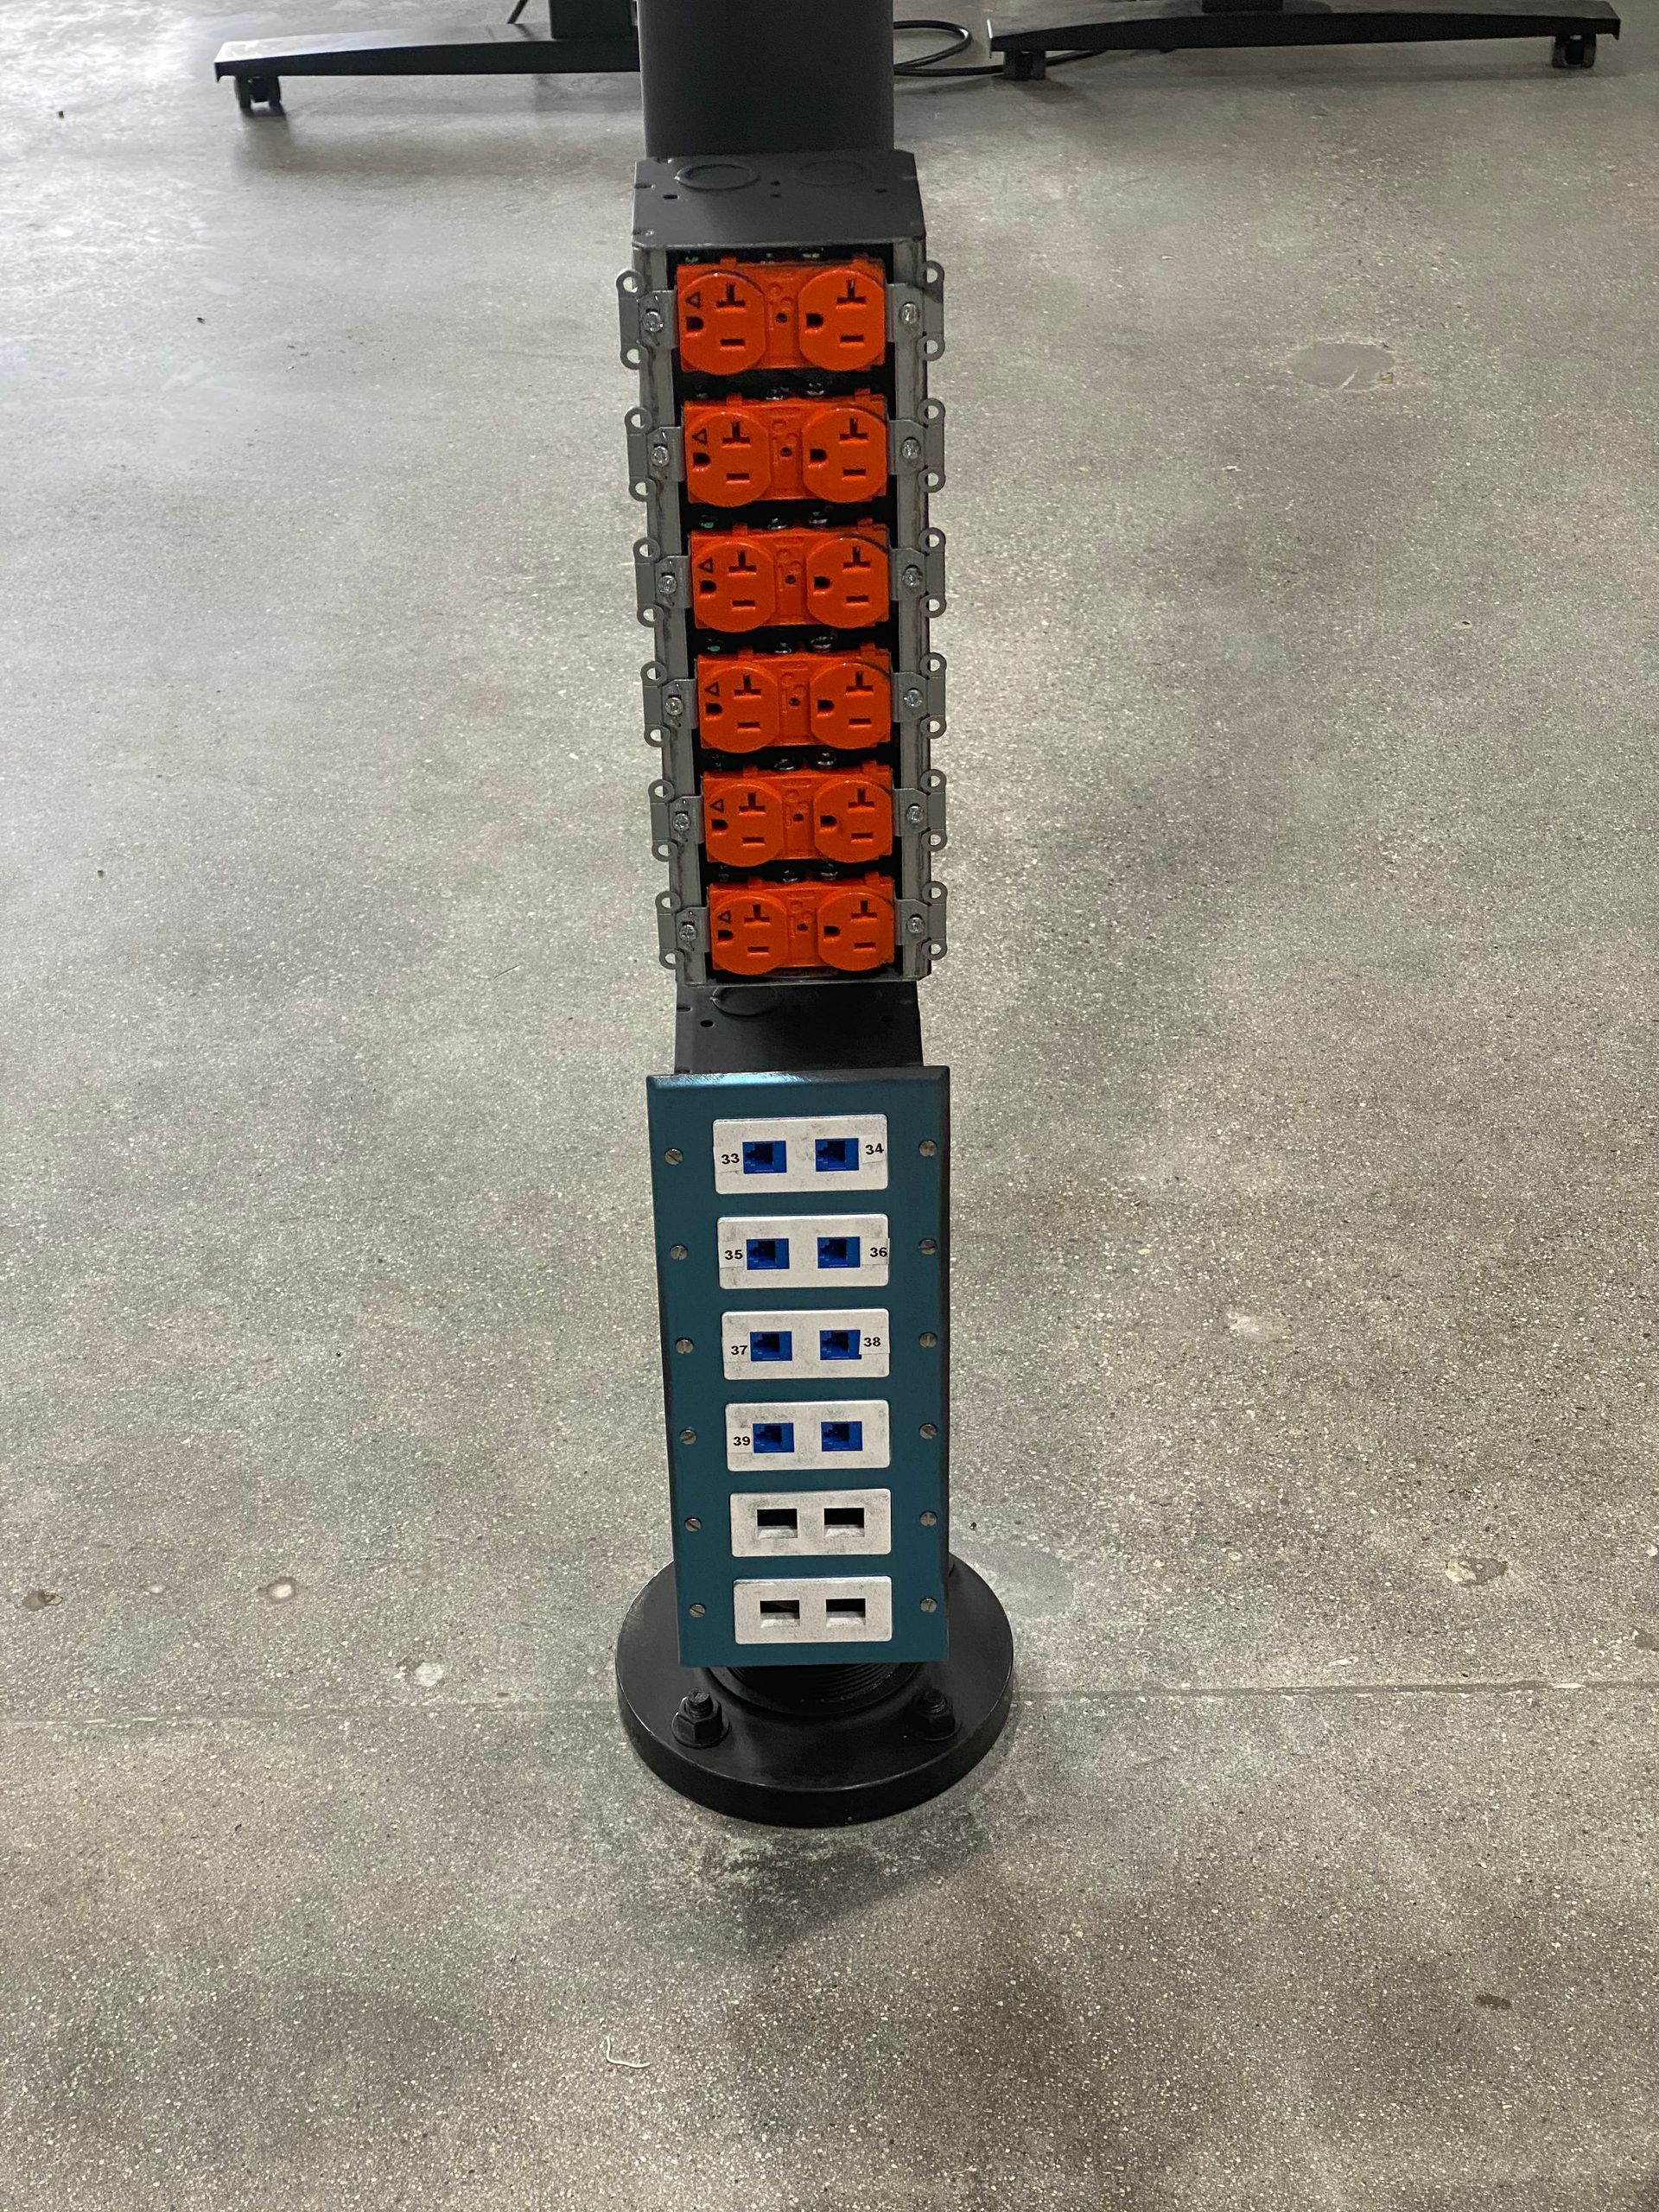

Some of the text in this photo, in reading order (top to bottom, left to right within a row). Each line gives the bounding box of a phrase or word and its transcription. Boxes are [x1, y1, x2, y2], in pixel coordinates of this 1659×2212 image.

[865, 1142, 885, 1155] 34
[721, 1153, 741, 1165] 33
[724, 1249, 744, 1261] 35
[869, 1247, 888, 1258] 36
[863, 1337, 881, 1348] 38
[730, 1344, 748, 1356] 37
[733, 1435, 751, 1446] 39
